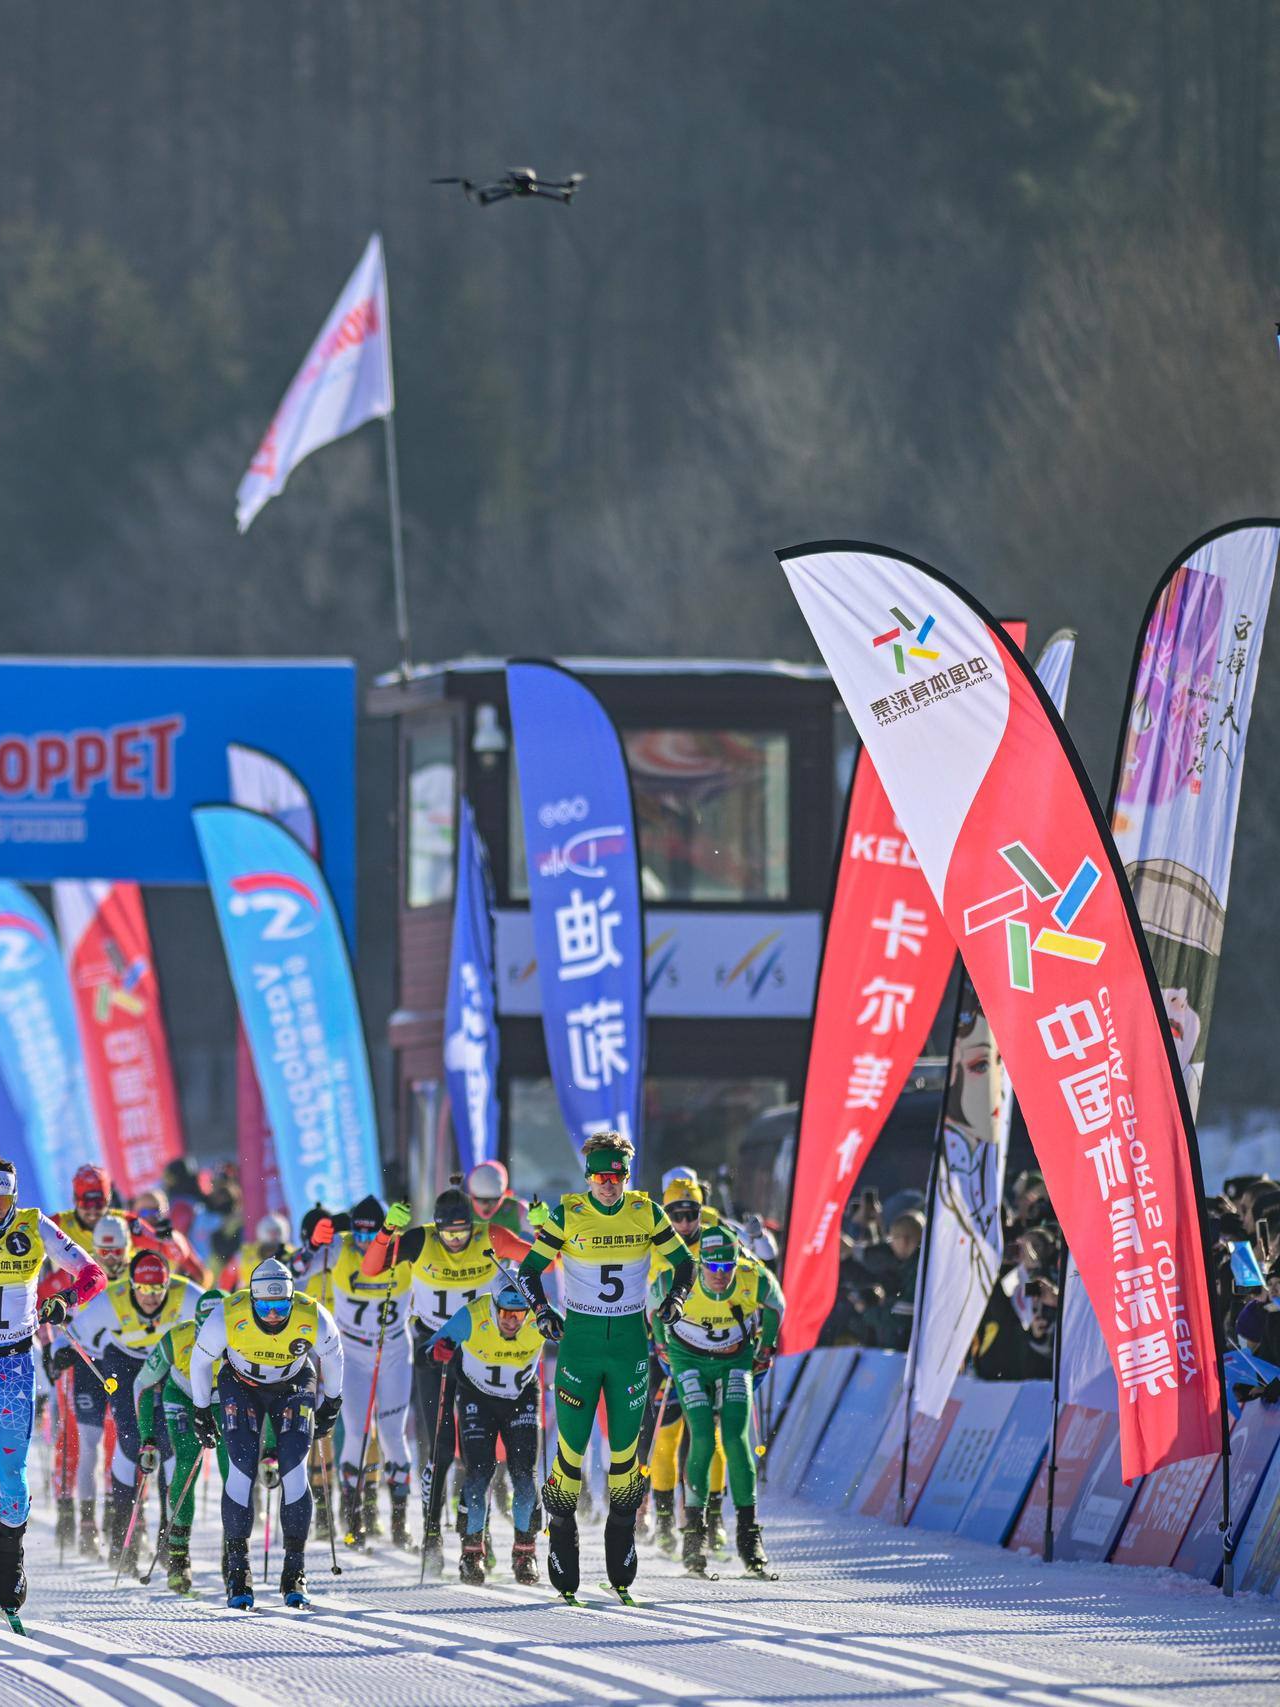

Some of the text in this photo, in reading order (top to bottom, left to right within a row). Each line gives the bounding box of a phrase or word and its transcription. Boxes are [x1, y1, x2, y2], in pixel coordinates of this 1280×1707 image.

[13, 1233, 22, 1255] 1
[597, 1264, 625, 1304] 5
[347, 1298, 399, 1327] 78
[604, 1306, 621, 1314] JILIN
[294, 1343, 305, 1355] 3
[559, 1390, 581, 1407] NTNUI
